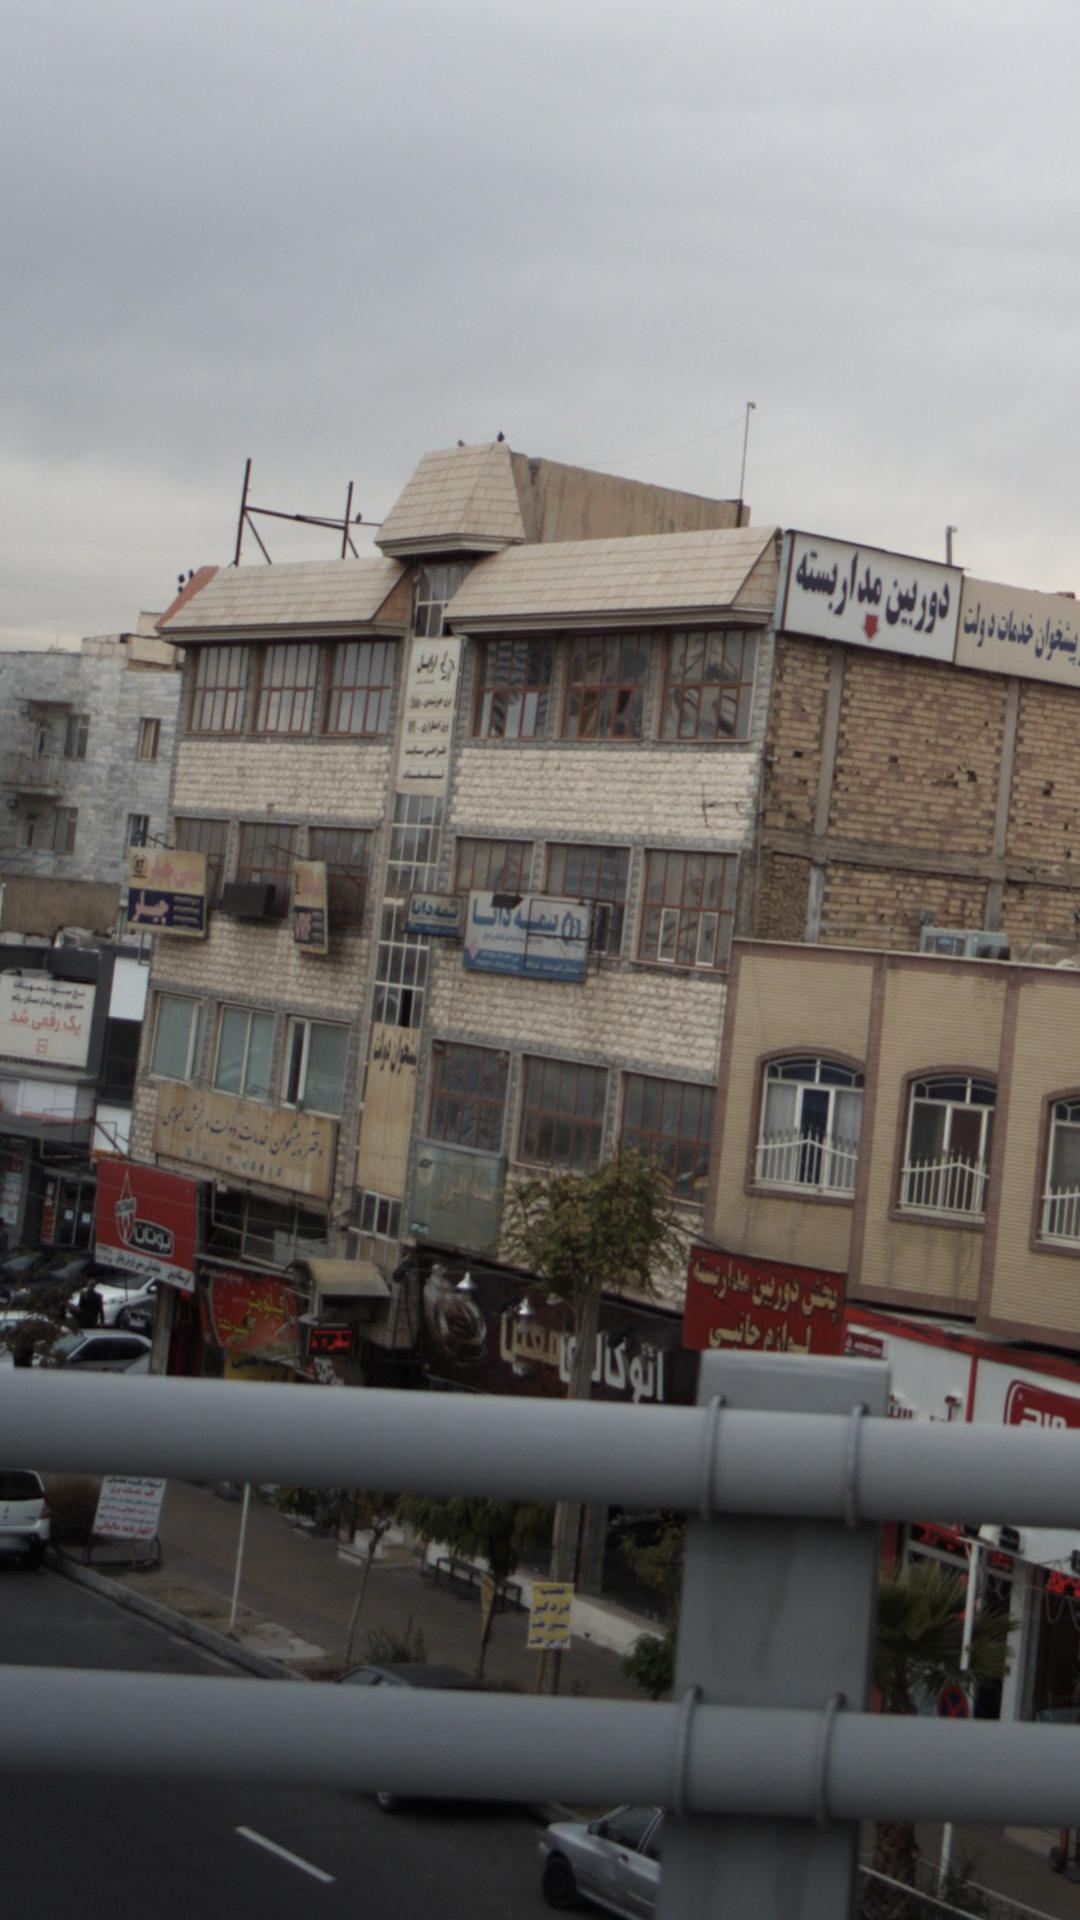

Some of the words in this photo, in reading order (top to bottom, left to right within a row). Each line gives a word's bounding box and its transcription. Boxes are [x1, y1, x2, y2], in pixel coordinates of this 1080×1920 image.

[885, 578, 950, 635] دوربین
[963, 602, 995, 648] دولت
[997, 609, 1034, 645] خدمات
[1035, 616, 1078, 666] پیشخوان
[411, 898, 433, 916] دانا
[434, 904, 458, 919] بیمه
[515, 909, 558, 932] بیمه
[9, 1006, 30, 1025] شد
[31, 1009, 61, 1032] رقمی
[63, 1014, 82, 1037] یک
[209, 1118, 237, 1136] دولت
[238, 1124, 269, 1146] خدمات
[270, 1119, 302, 1157] پیشخوان
[299, 1129, 323, 1160] دفتر
[134, 1224, 171, 1254] بوتان
[751, 1275, 801, 1313] دوربین
[801, 1276, 838, 1323] پخش
[709, 1310, 761, 1349] جانبی
